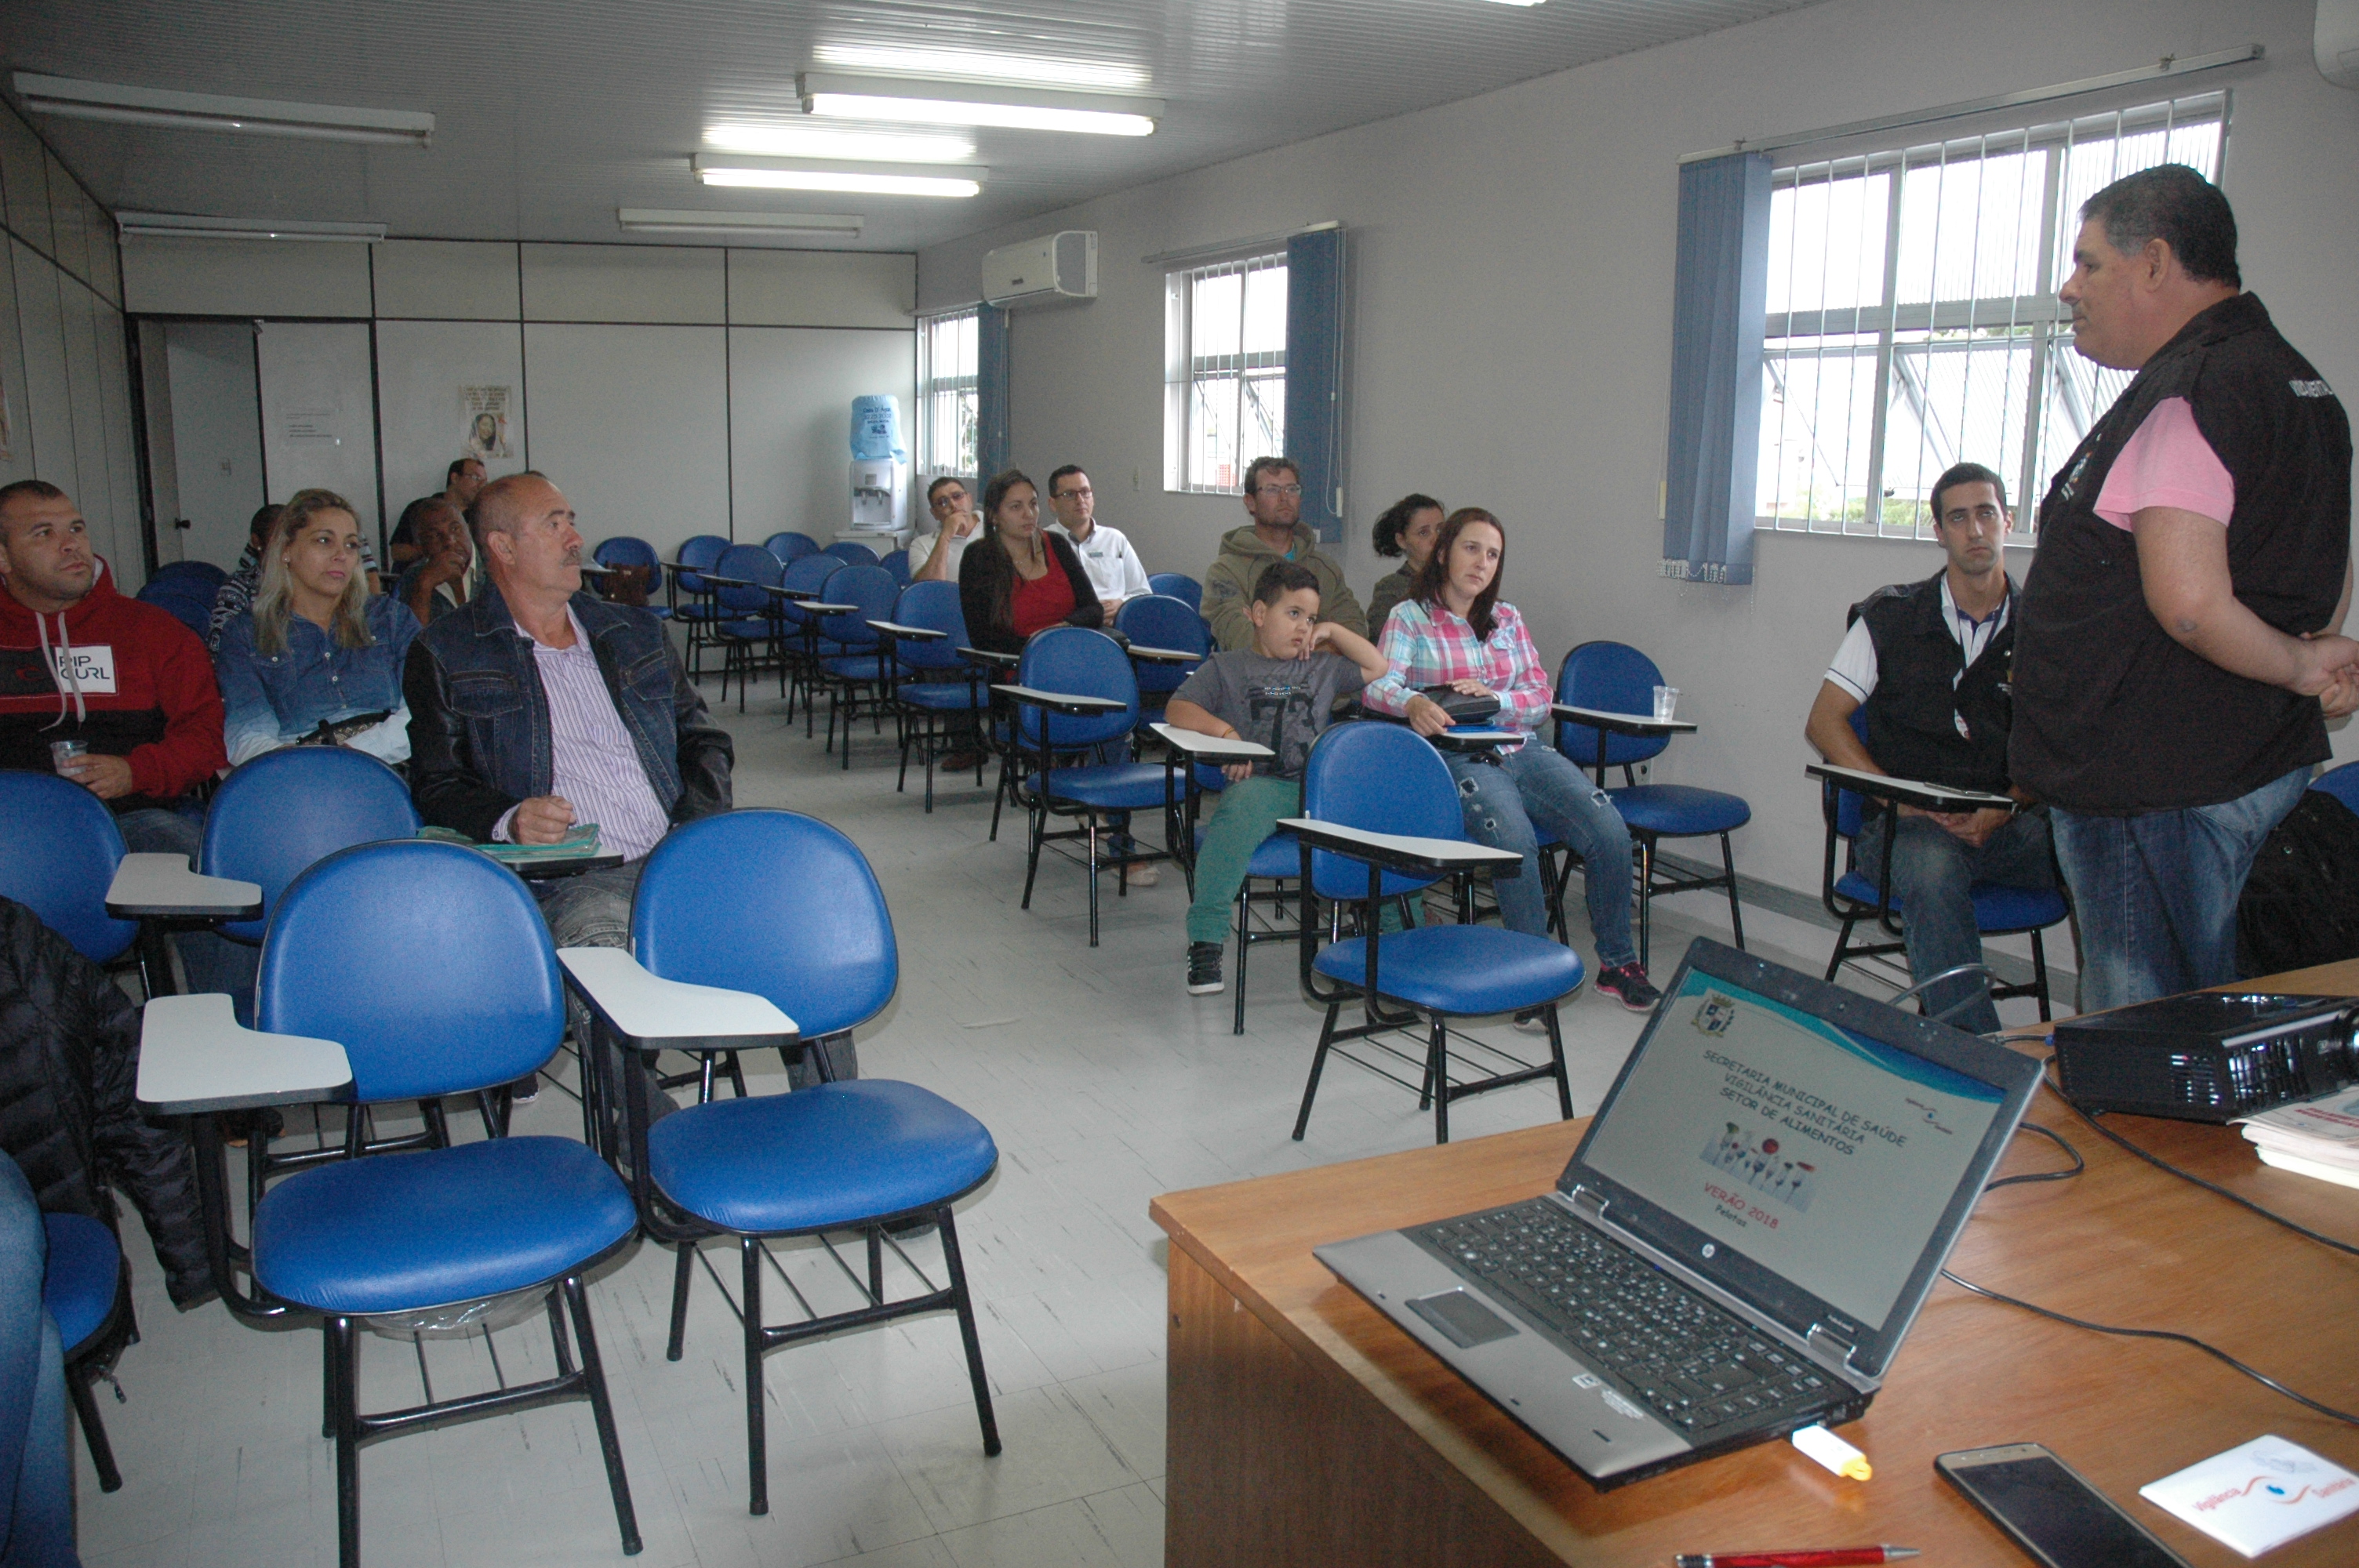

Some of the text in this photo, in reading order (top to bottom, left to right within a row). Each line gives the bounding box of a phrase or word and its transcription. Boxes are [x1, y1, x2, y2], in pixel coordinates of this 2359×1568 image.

[1702, 1049, 1908, 1149] SECRETARIA MUNICIPAL DE SAÚDE
[1719, 1087, 1856, 1156] SETOR DE ALIMENTOS
[1725, 1073, 1866, 1145] VIGILÂNCIA SANITÁRIA
[1704, 1182, 1779, 1229] VERÃO 2018
